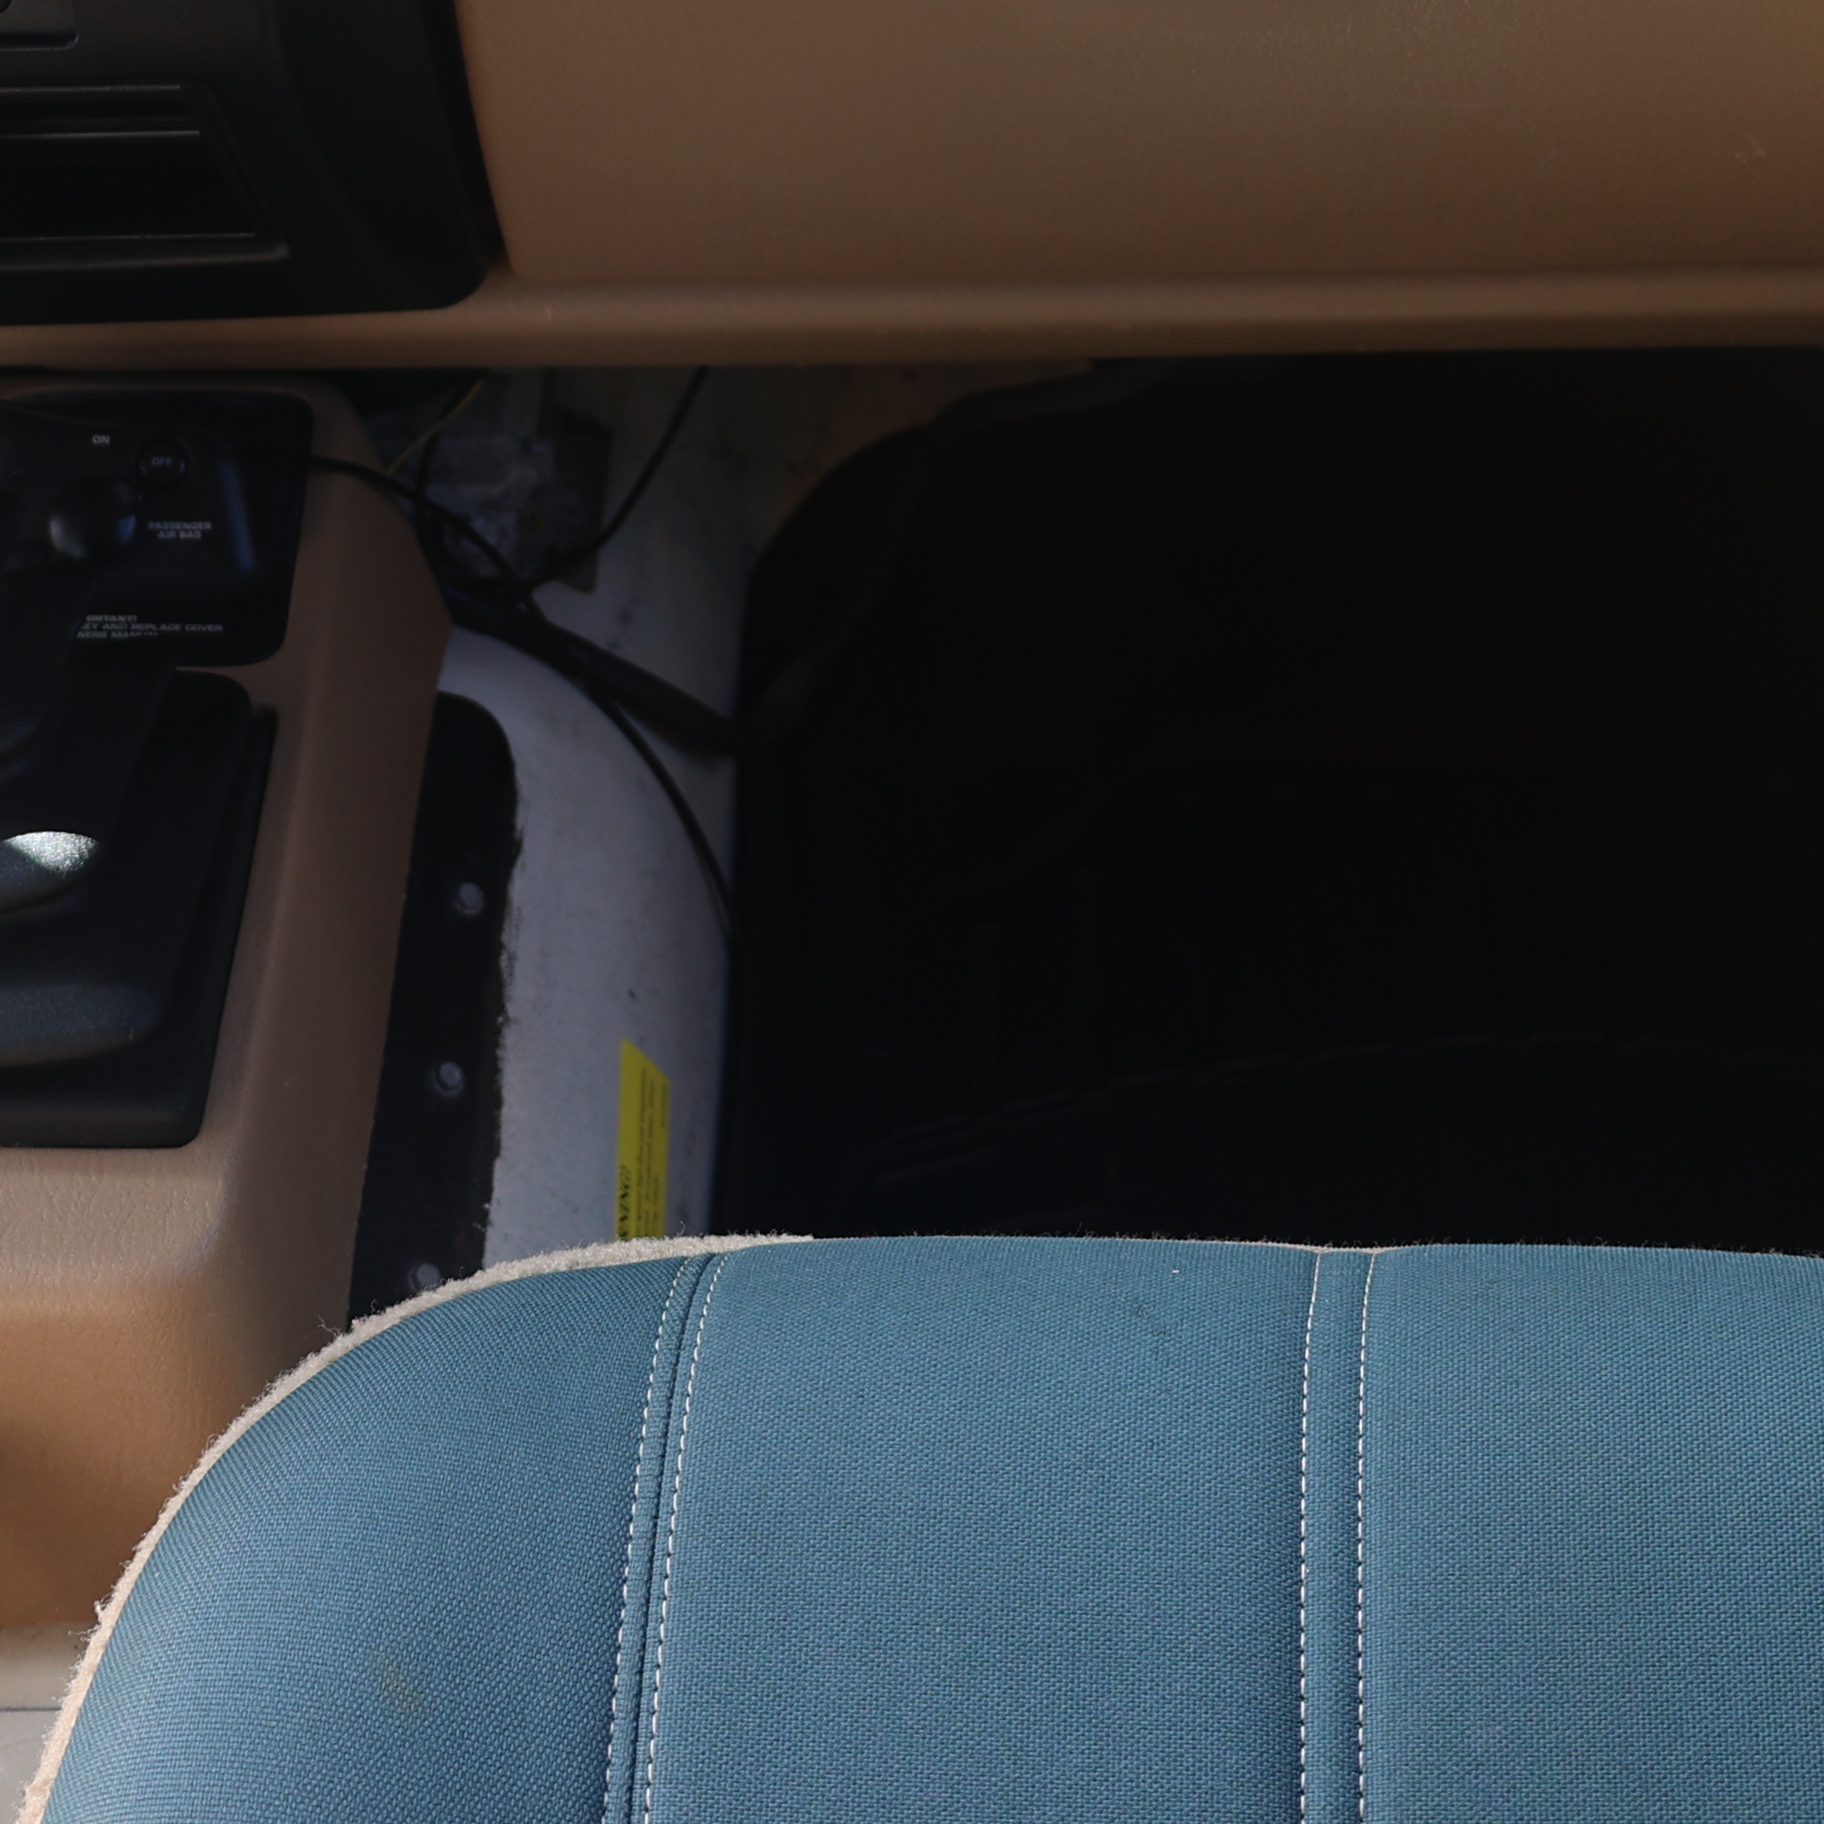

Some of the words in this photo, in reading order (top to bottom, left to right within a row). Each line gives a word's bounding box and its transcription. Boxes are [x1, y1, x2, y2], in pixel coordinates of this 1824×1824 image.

[92, 434, 111, 445] ON
[151, 457, 173, 466] OFF
[148, 521, 212, 531] PASSENGER
[158, 530, 177, 539] AIR
[179, 530, 202, 539] BAG
